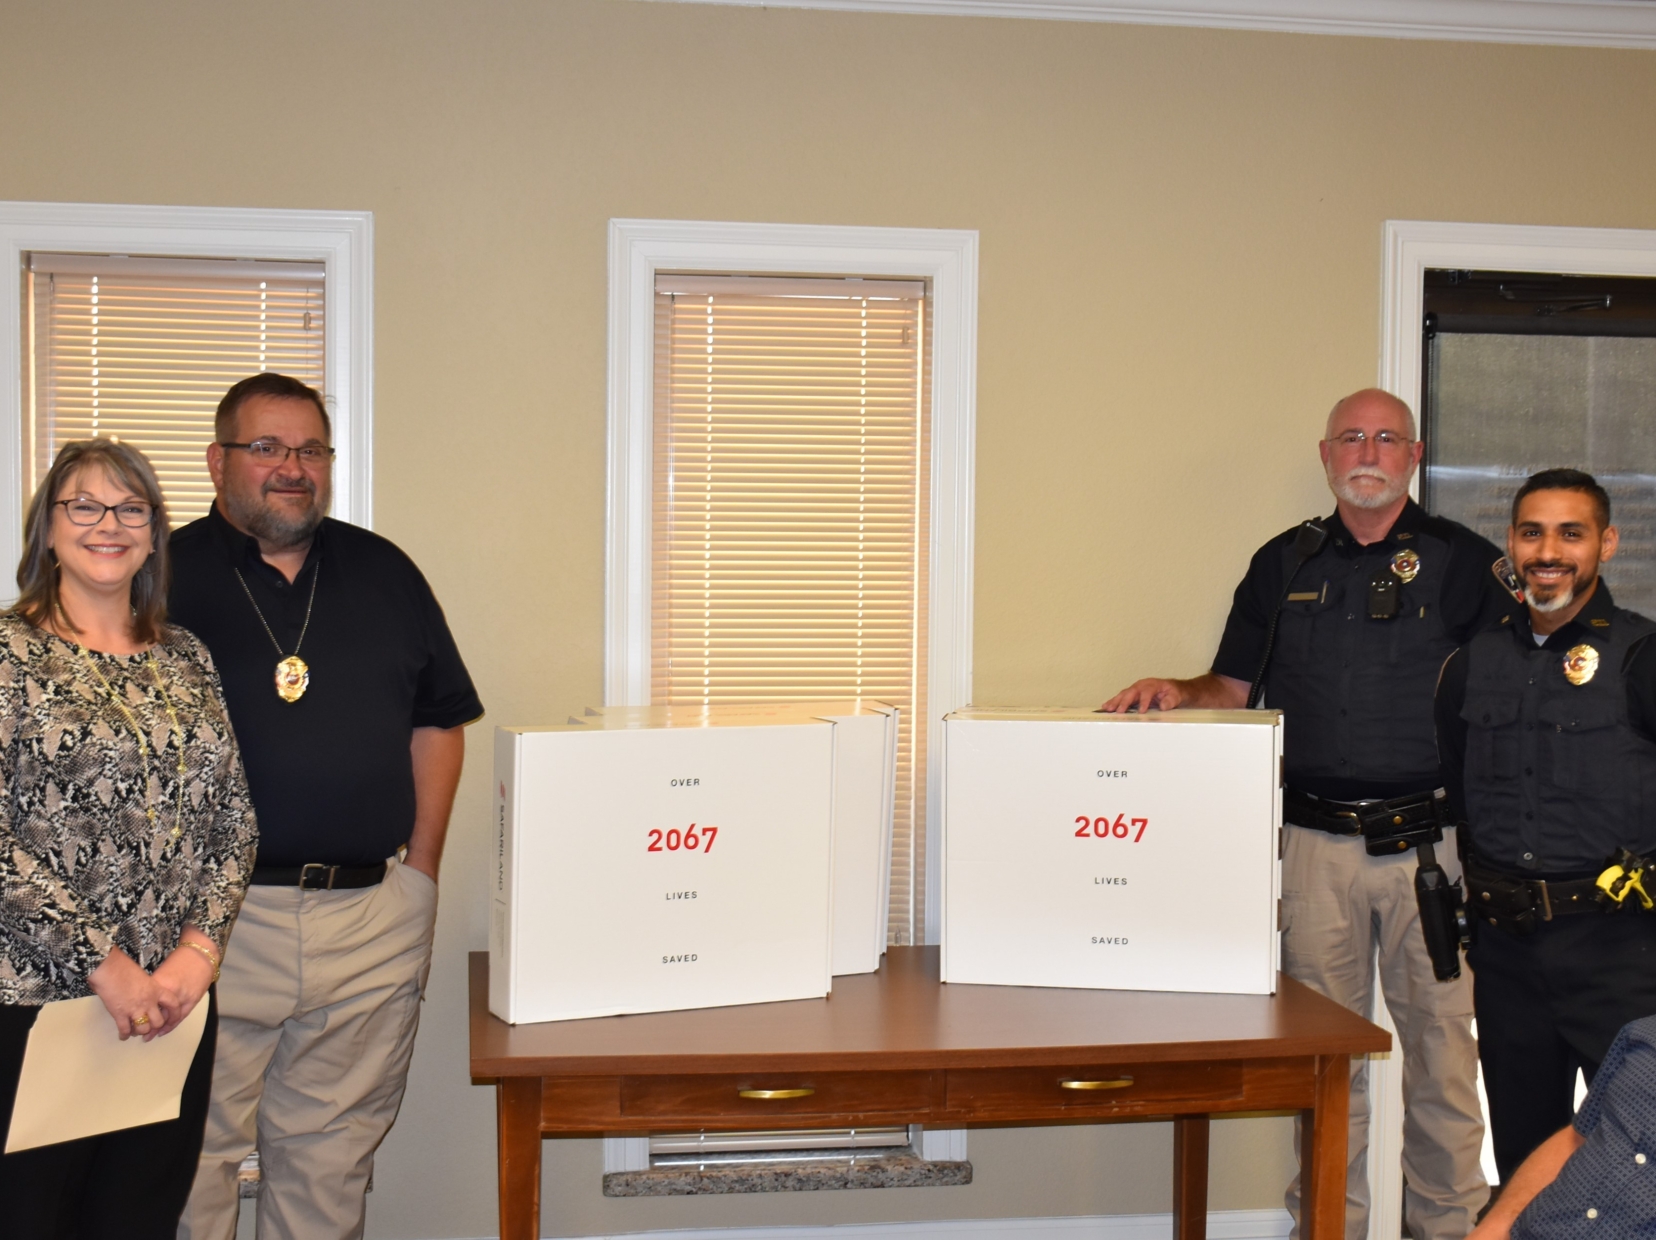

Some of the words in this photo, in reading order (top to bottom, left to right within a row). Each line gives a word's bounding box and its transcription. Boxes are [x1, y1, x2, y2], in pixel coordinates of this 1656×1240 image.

[1096, 769, 1129, 779] OVER
[670, 778, 701, 788] OVER
[1074, 813, 1149, 843] 2067
[647, 824, 718, 854] 2067
[1094, 876, 1128, 886] LIVES
[665, 890, 698, 901] LIVES
[1091, 936, 1129, 946] SAVED
[662, 954, 698, 965] SAVED
